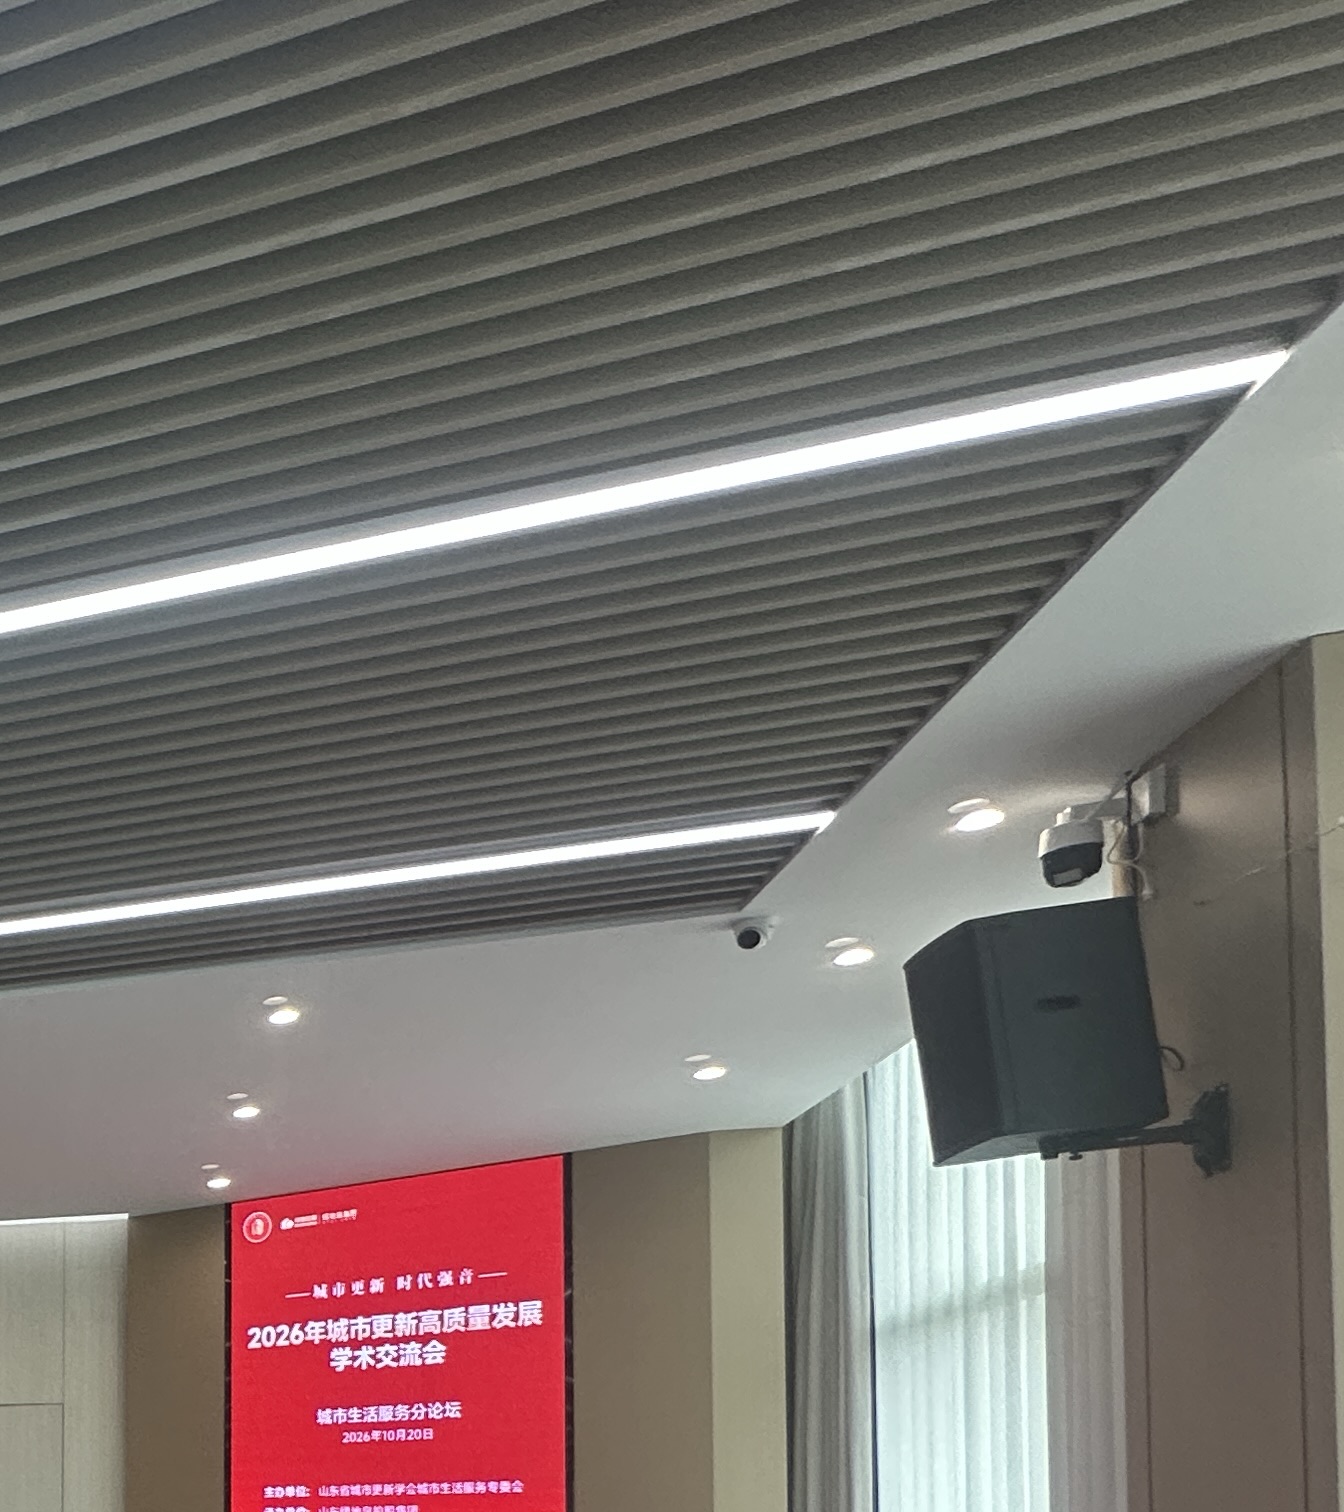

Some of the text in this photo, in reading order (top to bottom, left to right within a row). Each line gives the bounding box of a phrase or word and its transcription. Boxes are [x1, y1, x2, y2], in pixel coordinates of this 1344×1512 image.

[312, 1268, 474, 1299] 城市更新 时代强音
[246, 1300, 544, 1349] 2026年城市更新高质量发展
[329, 1339, 447, 1372] 学术交流会
[316, 1401, 463, 1426] 城市生活服务分论坛
[341, 1427, 434, 1444] 2026年10月20日
